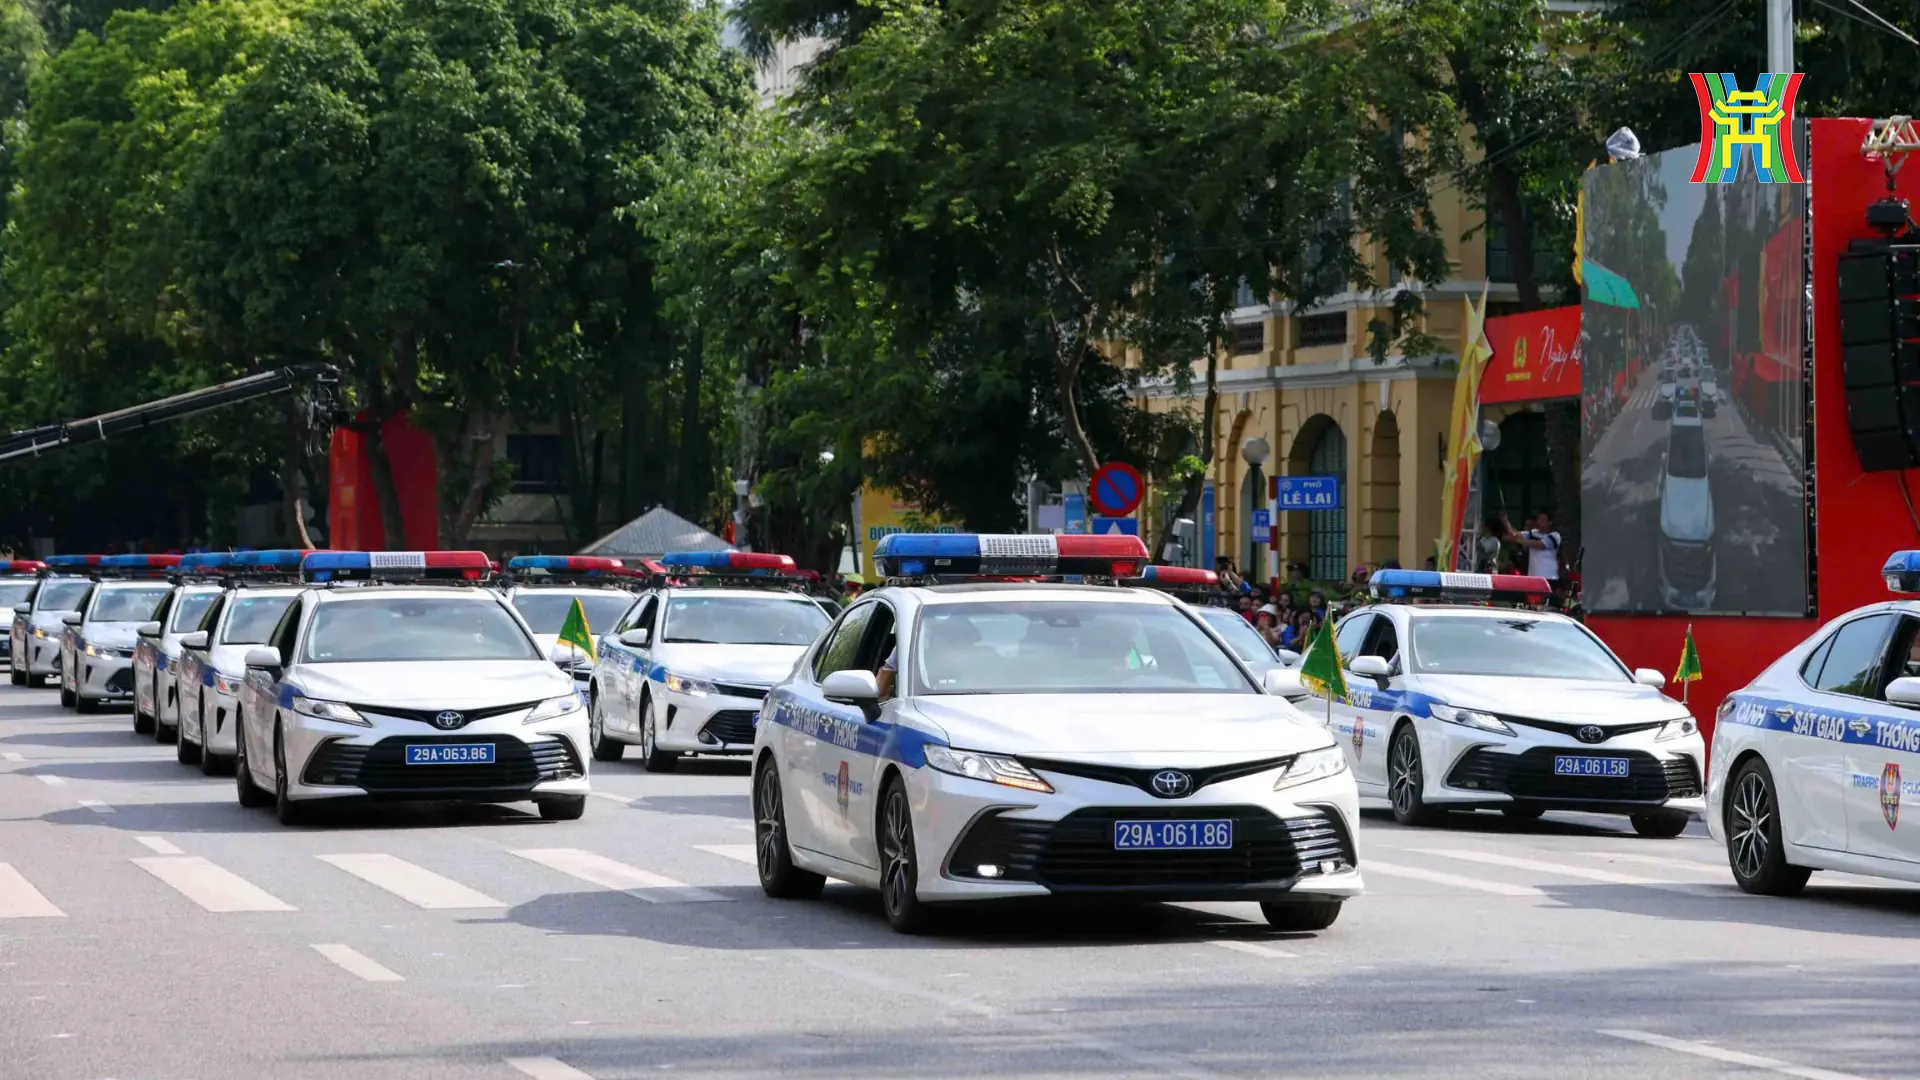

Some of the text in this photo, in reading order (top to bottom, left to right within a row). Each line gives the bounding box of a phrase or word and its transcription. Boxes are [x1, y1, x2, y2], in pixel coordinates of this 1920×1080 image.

[1539, 325, 1568, 382] Ngày
[1305, 492, 1332, 504] LAI
[1793, 707, 1818, 736] SÁT
[1817, 714, 1846, 741] GIAO
[413, 747, 488, 761] 29A-063.86
[1557, 758, 1627, 775] 29A-061.58
[1853, 774, 1880, 789] TRAFFIC
[1118, 823, 1229, 846] 29A-061.86
